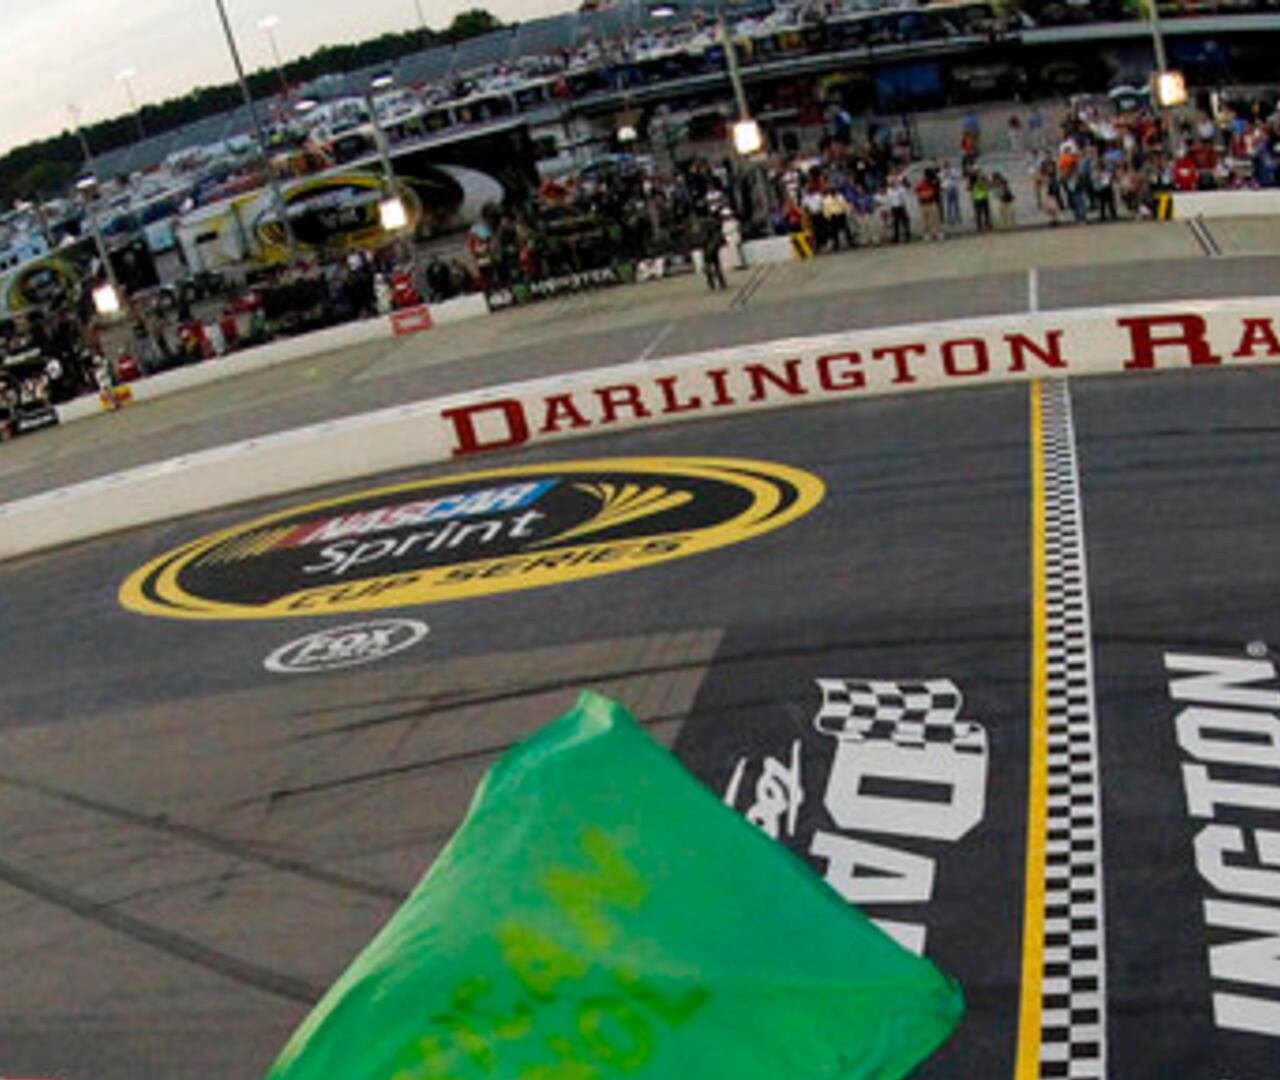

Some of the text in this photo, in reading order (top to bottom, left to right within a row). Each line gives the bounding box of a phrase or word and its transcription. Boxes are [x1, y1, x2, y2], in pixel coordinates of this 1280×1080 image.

[442, 328, 1069, 457] DARLINGTON
[300, 480, 548, 546] NASCAR
[285, 535, 695, 611] CUP SERIES
